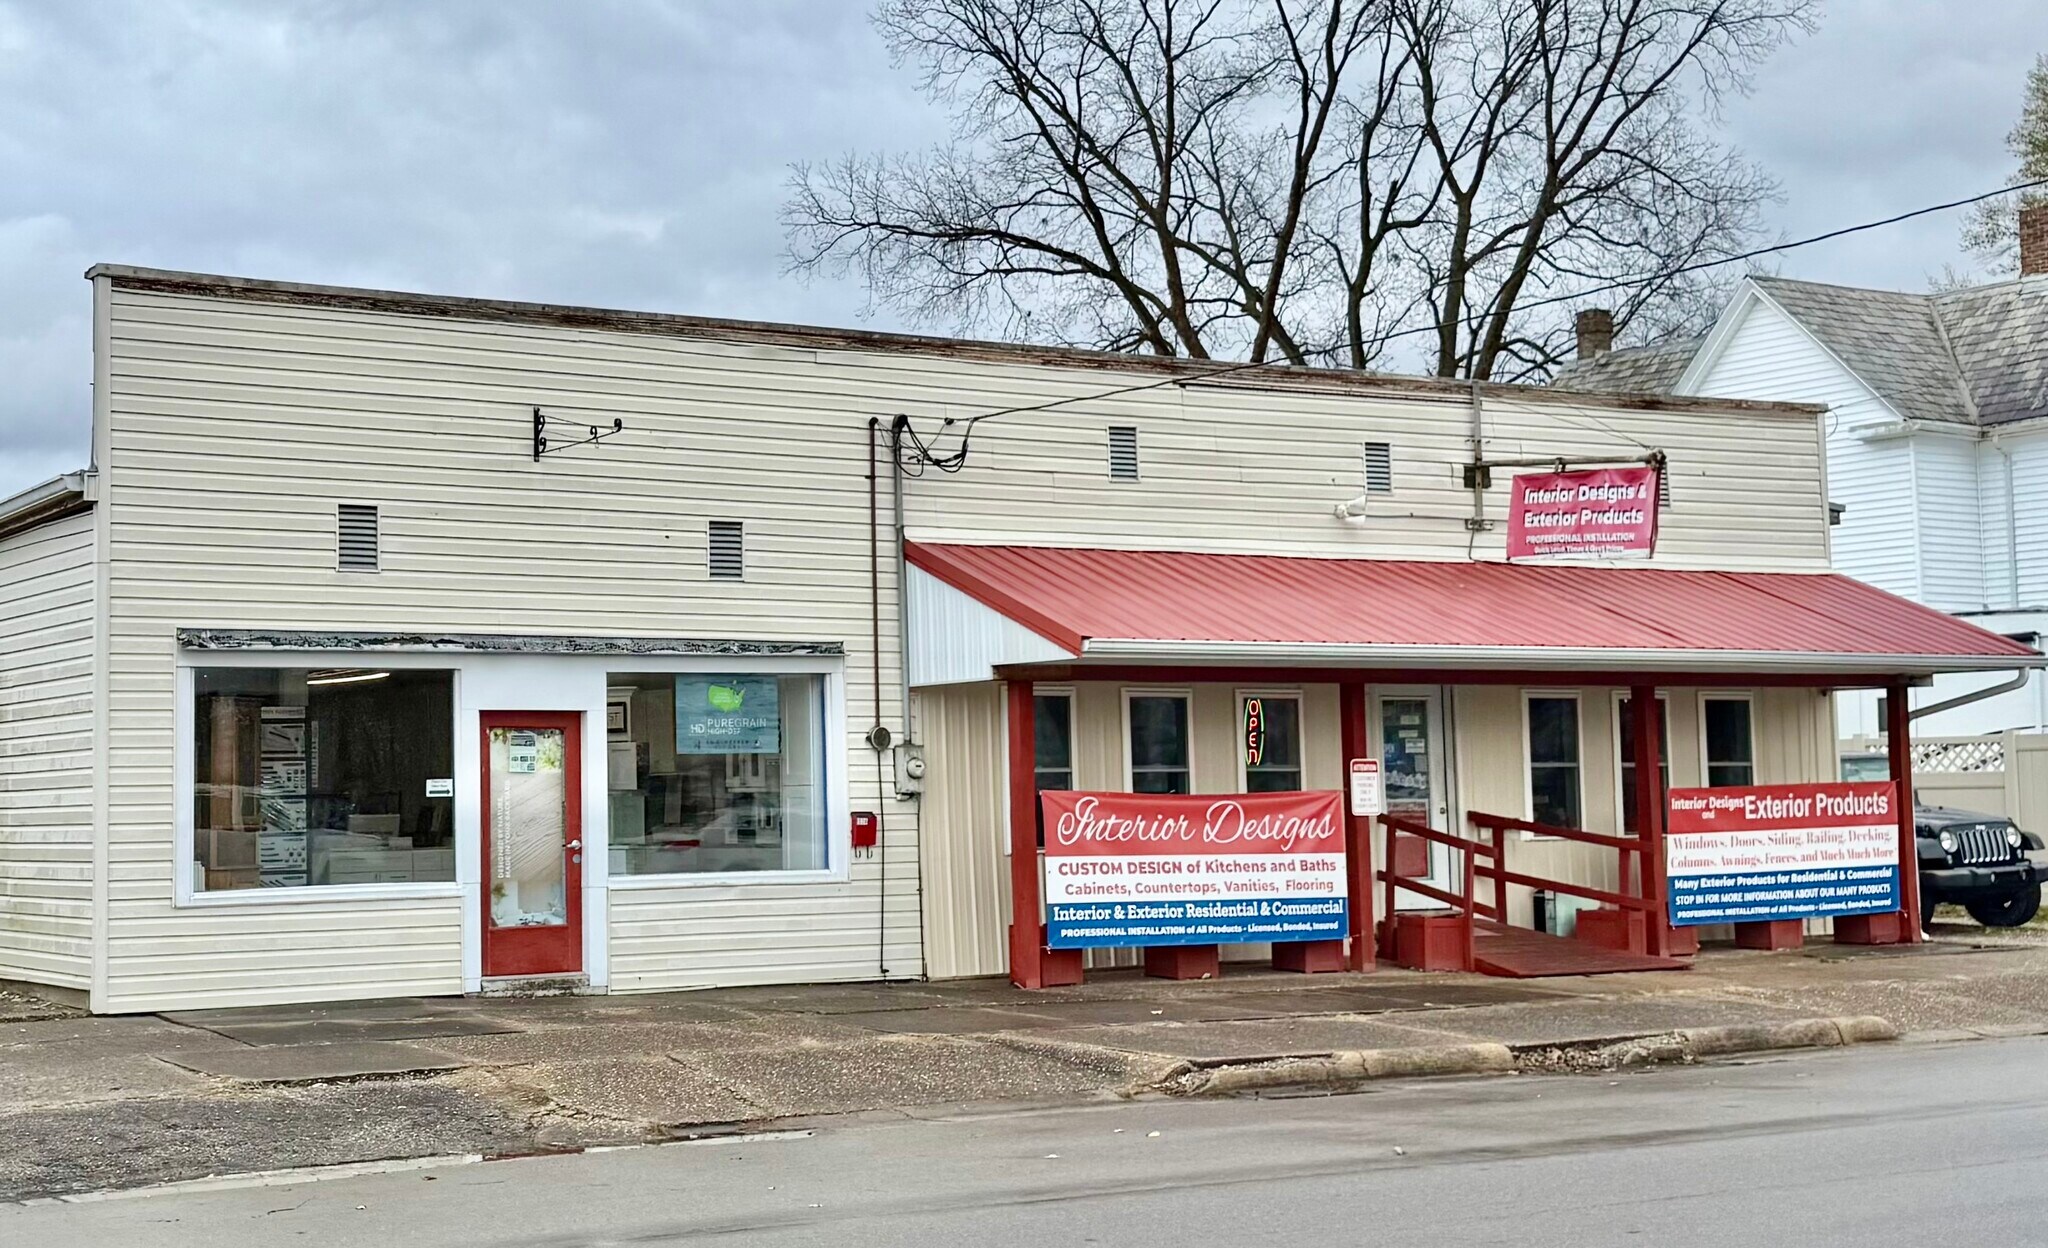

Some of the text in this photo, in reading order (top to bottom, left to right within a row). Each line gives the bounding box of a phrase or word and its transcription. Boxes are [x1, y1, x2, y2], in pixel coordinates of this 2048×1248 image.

[1524, 483, 1647, 504] Interior Designs &
[1524, 508, 1644, 528] Exterior Products
[690, 724, 705, 733] HD
[707, 718, 767, 728] PUREGRAIN
[1249, 700, 1259, 763] OPEN
[1671, 795, 1744, 812] Interior Designs
[1744, 790, 1889, 820] Exterior Products
[1057, 796, 1336, 852] Interior Designs
[1702, 810, 1715, 819] and
[1801, 850, 1817, 862] and
[1820, 849, 1845, 862] Much
[1847, 848, 1871, 860] Much
[1058, 859, 1337, 876] CUSTOM DESIGN of Kitchens and Baths
[1065, 878, 1334, 896] Cabinets, Countertops, Vanities, Flooring
[1675, 867, 1892, 891] Many Exterior Products for Residential & Commercial
[1676, 884, 1891, 905] STOP IN FOR MORE INFORMATION ABOUT OUR MANY PRODUCTS
[1053, 899, 1344, 921] Interior & Exterior Residential & Commercial
[1060, 928, 1127, 938] PROFESSIONAL
[1127, 926, 1186, 936] INSTALLATION
[1186, 925, 1196, 934] of
[1196, 925, 1208, 934] All
[1208, 925, 1243, 933] Products
